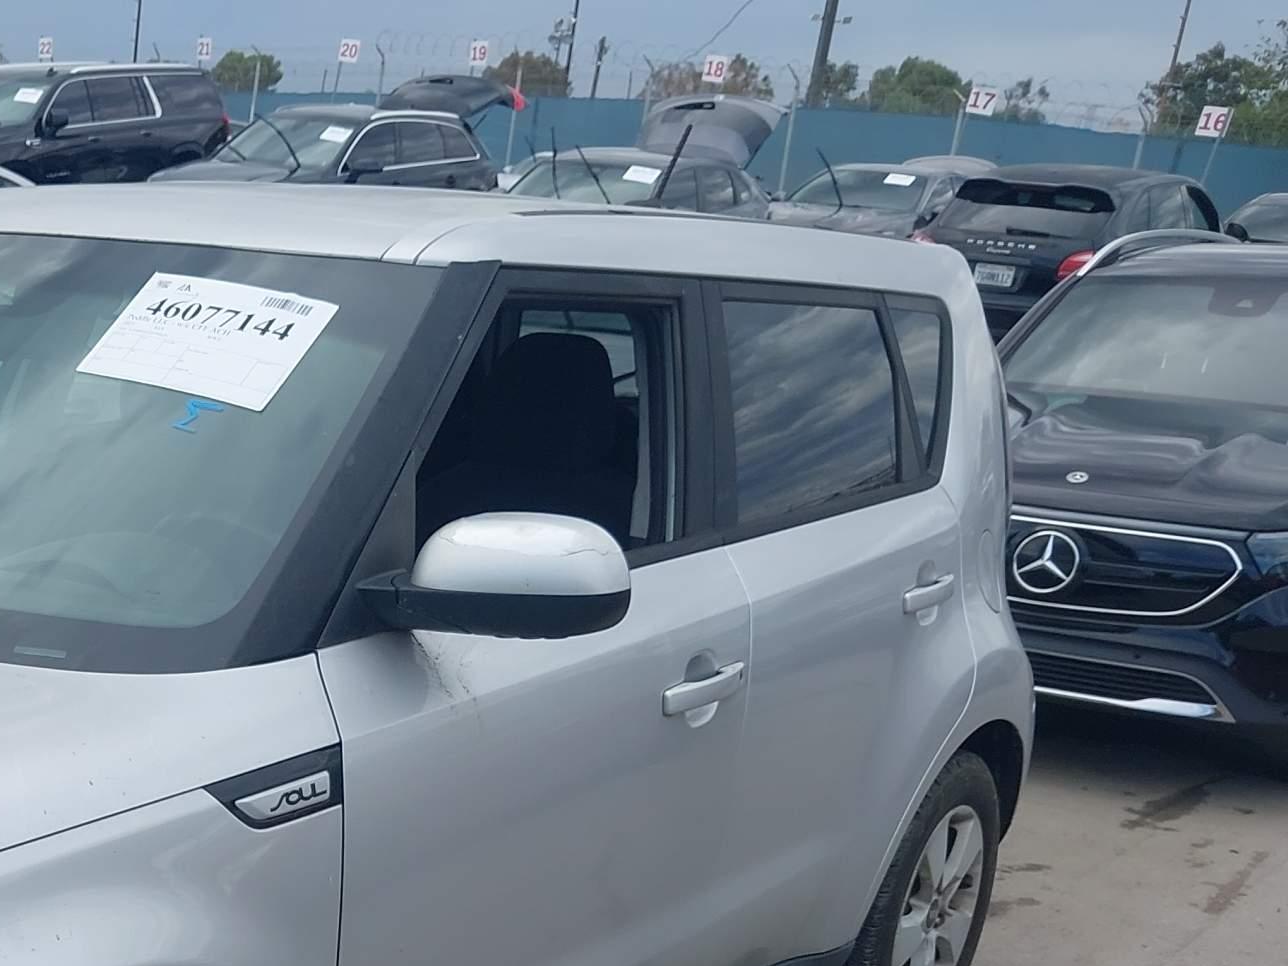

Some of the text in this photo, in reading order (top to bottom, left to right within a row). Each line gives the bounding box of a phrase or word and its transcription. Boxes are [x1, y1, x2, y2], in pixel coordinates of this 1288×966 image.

[39, 41, 52, 55] 22
[198, 41, 210, 56] 21
[341, 42, 358, 58] 20
[471, 45, 487, 61] 19
[706, 60, 725, 78] 18
[968, 90, 996, 111] 17
[1198, 111, 1227, 132] 16
[145, 297, 296, 341] 46077144
[269, 782, 328, 813] SOUL
